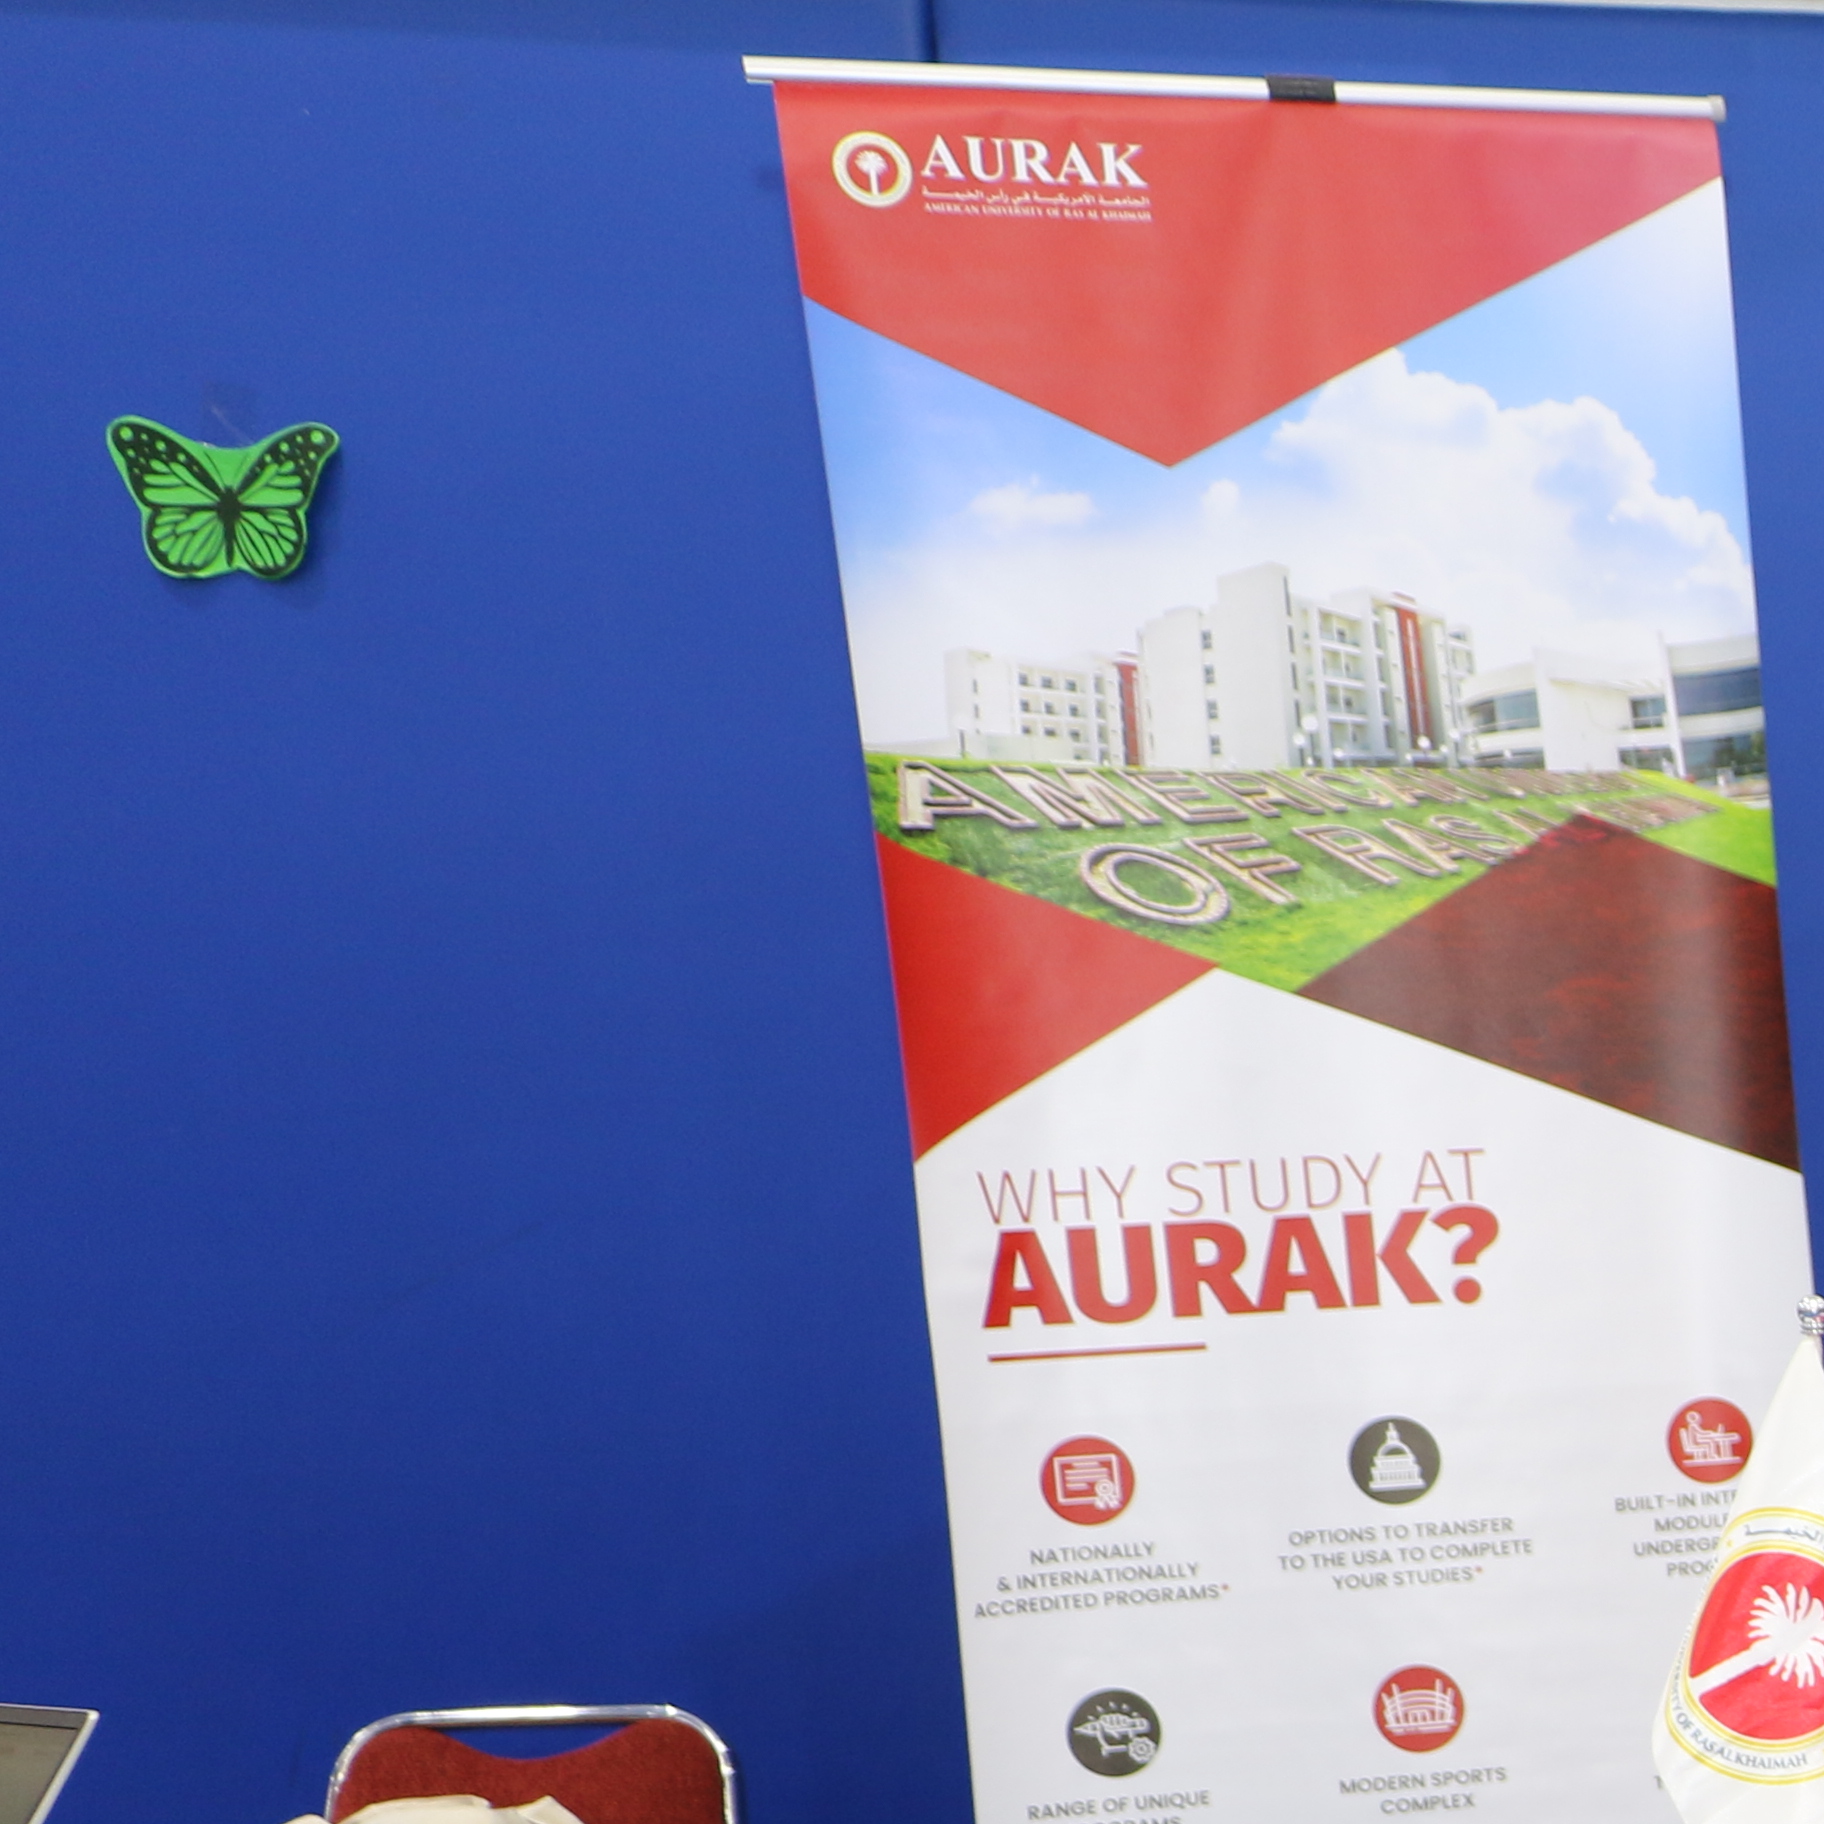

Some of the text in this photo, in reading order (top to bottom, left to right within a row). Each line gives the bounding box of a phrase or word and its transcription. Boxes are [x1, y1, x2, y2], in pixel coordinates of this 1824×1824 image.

[920, 133, 1148, 188] AURAK
[924, 201, 980, 215] AMERICAN
[981, 203, 1045, 217] UNIVERSITY
[1063, 208, 1085, 219] RAS
[1102, 209, 1152, 221] KHAIMAH
[1080, 832, 1301, 926] OF
[976, 1148, 1485, 1225] WHY STUDY AT
[981, 1205, 1500, 1330] AURAK?
[1614, 1493, 1697, 1512] BUILT-IN
[1288, 1516, 1514, 1548] OPTIONS TO TRANSFER
[1029, 1540, 1157, 1566] NATIONALLY
[1277, 1537, 1534, 1572] TO THE USA TO COMPLETE
[995, 1562, 1200, 1593] & INTERNATIONALLY
[1331, 1572, 1388, 1591] YOUR
[974, 1590, 1099, 1620] ACCREDITED
[1338, 1765, 1508, 1796] MODERN SPORTS
[1027, 1789, 1211, 1822] RANGE OF UNIQUE
[1380, 1792, 1476, 1815] COMPLEX
